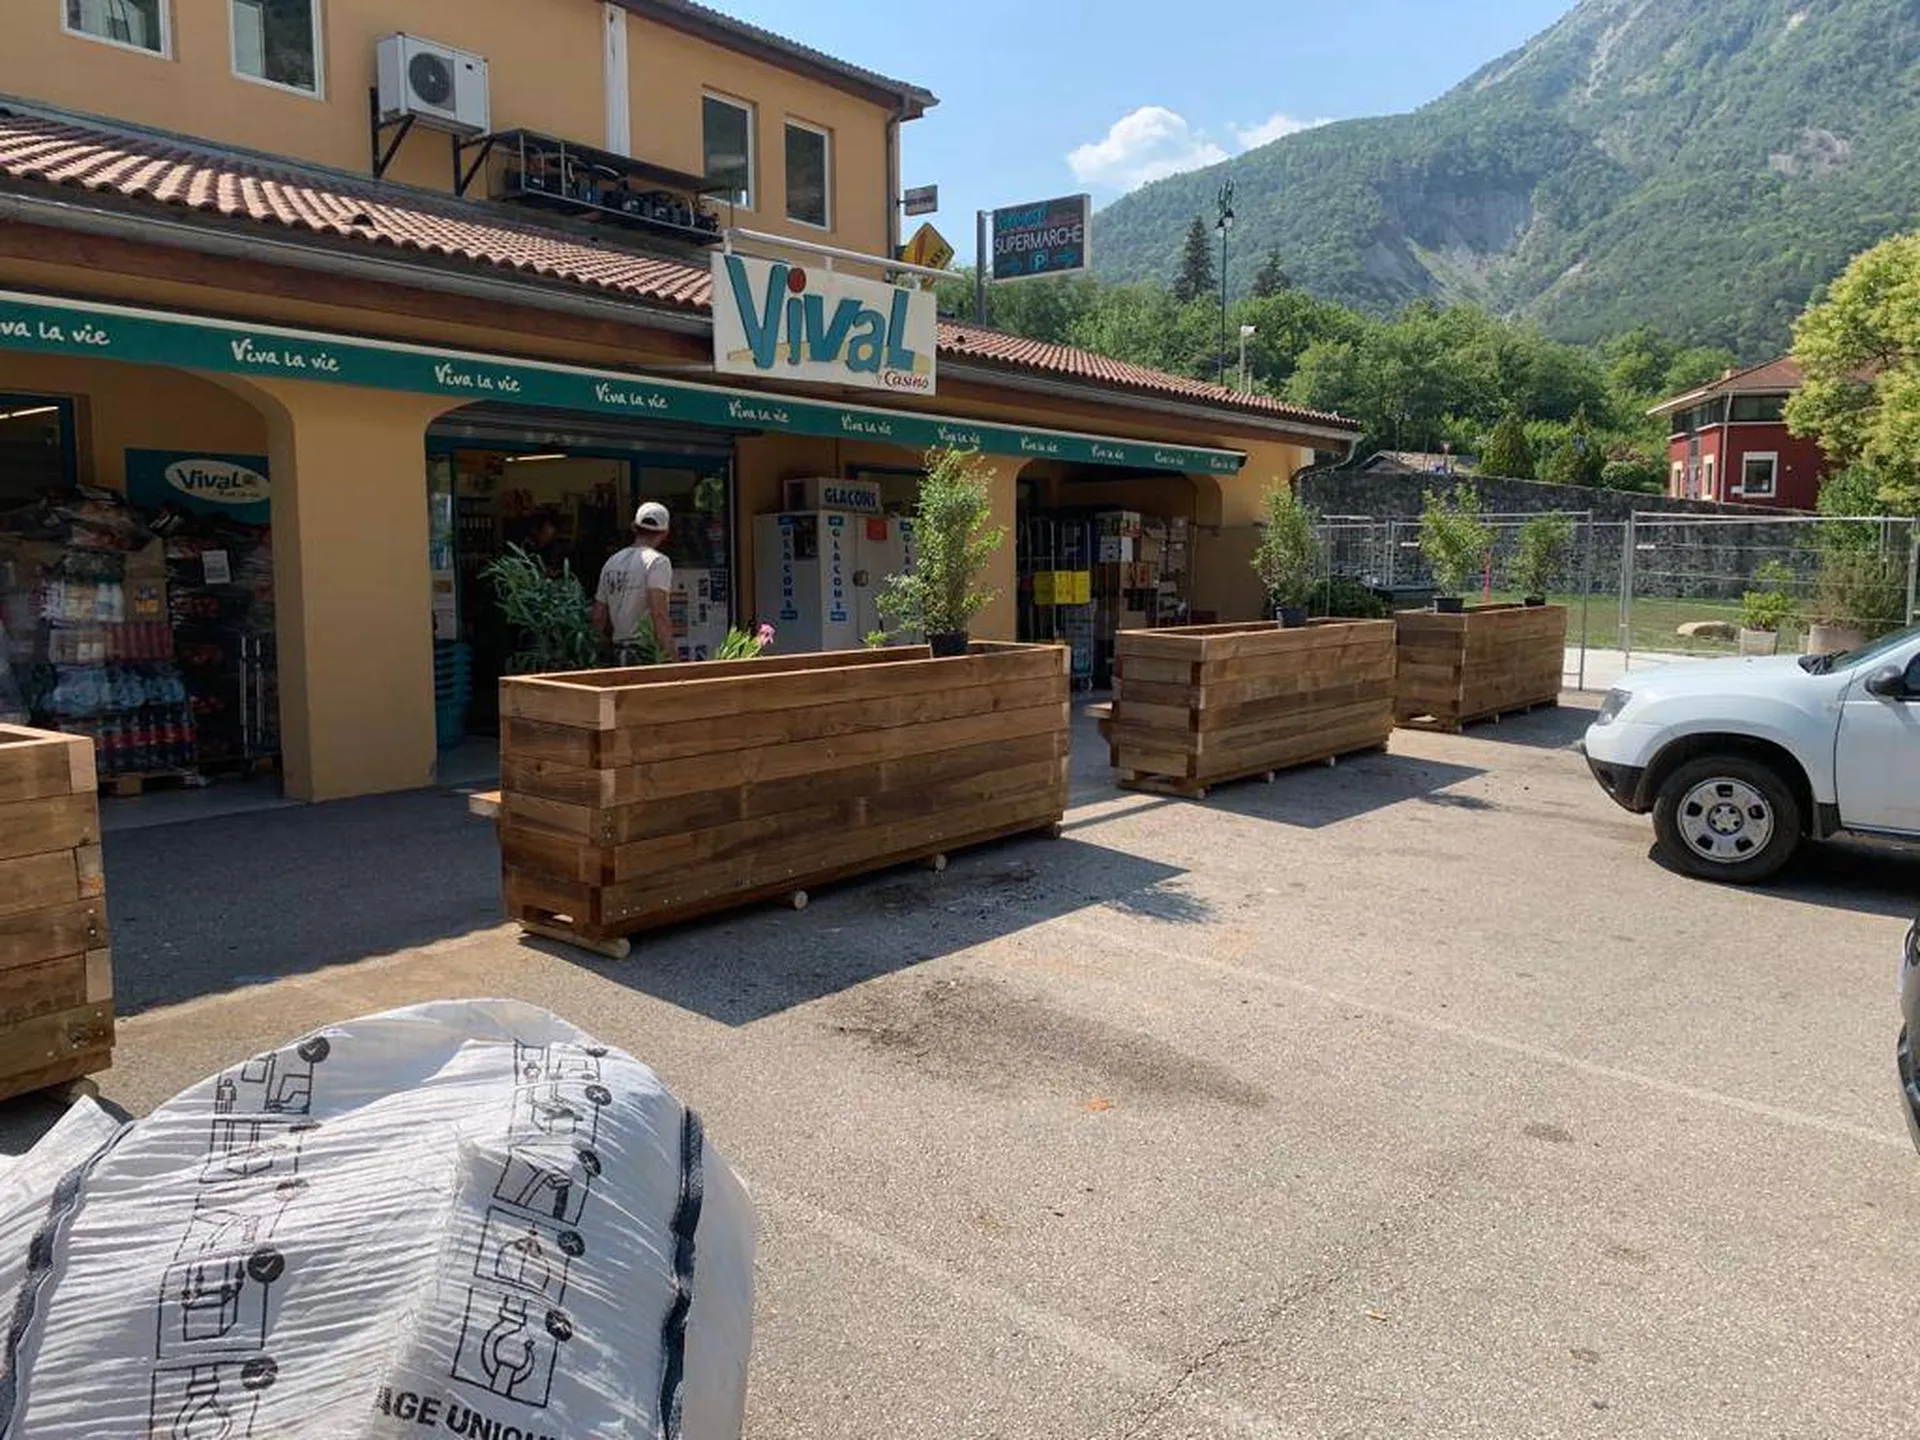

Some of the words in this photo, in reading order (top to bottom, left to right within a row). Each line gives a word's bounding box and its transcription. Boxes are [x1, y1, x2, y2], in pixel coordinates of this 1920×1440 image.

[0, 321, 32, 338] va
[72, 323, 111, 346] vie
[231, 337, 280, 365] Viva
[311, 352, 341, 373] vie
[434, 362, 474, 387] Viva
[497, 374, 521, 393] vie
[884, 370, 929, 389] Casino
[595, 382, 628, 406] Viva
[647, 391, 669, 410] vie
